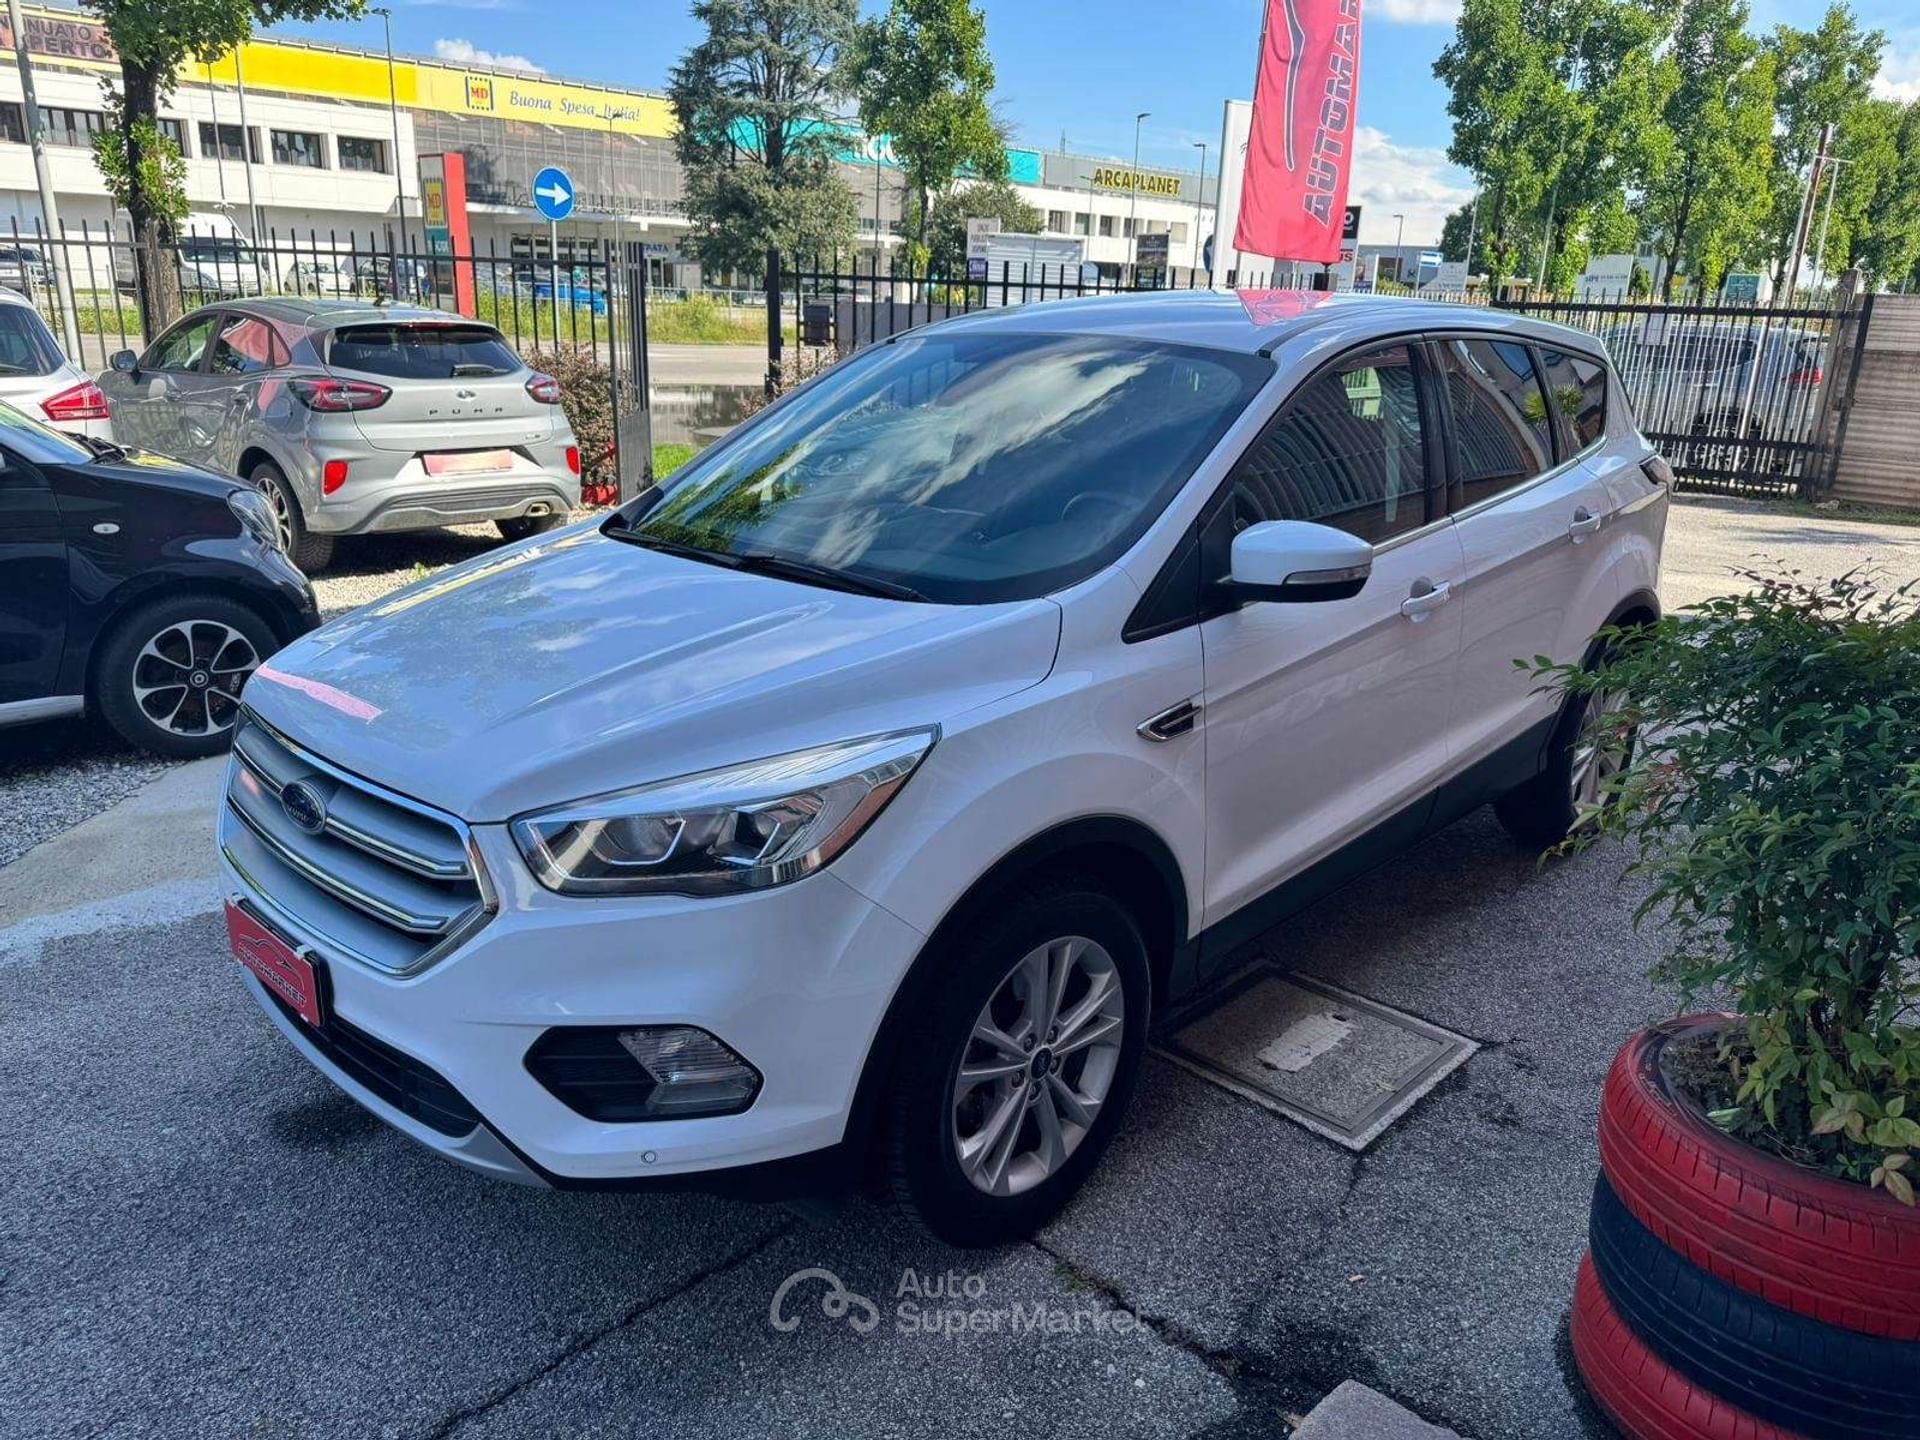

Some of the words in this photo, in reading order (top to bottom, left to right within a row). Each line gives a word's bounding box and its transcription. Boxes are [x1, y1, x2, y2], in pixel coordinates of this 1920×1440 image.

[471, 86, 489, 99] MD
[510, 90, 551, 110] Buona
[560, 97, 595, 116] Spesa
[603, 103, 641, 122] Italia!
[1094, 168, 1180, 195] ARCAPLANET
